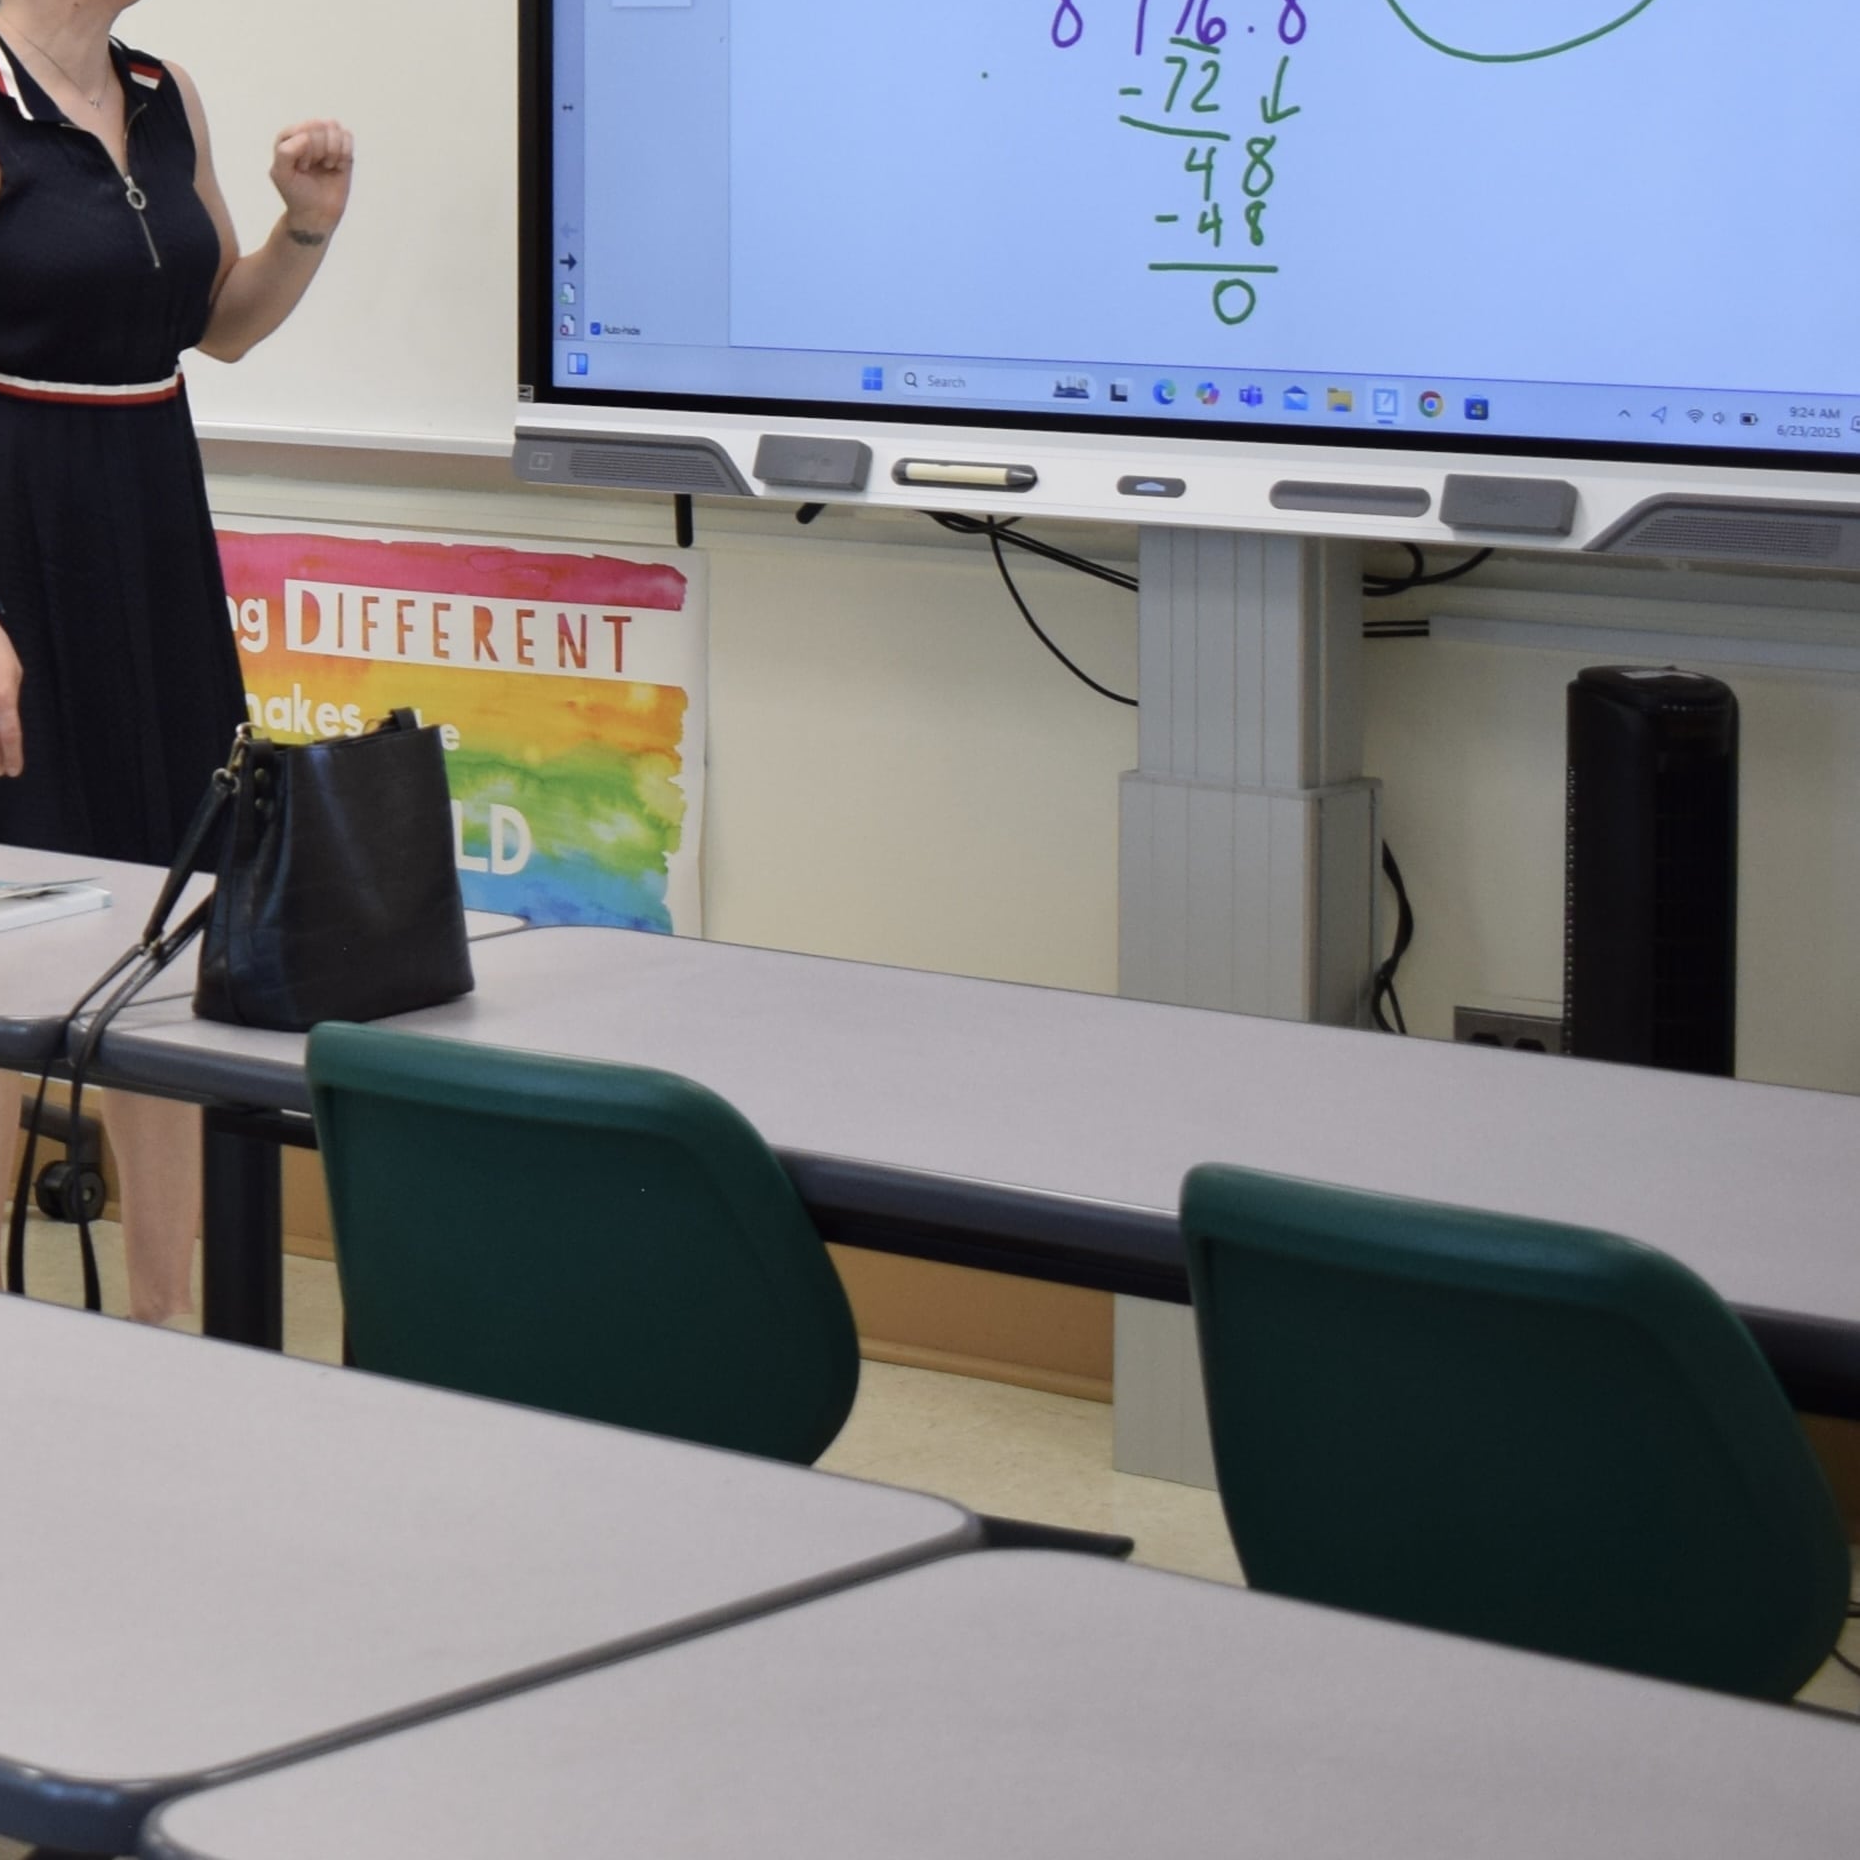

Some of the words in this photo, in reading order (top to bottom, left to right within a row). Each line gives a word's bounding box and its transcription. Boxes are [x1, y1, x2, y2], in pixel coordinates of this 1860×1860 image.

[927, 374, 966, 388] Search
[1820, 408, 1840, 419] AM
[1777, 425, 1840, 438] 6/23/2025
[301, 589, 632, 673] DIFFERENT
